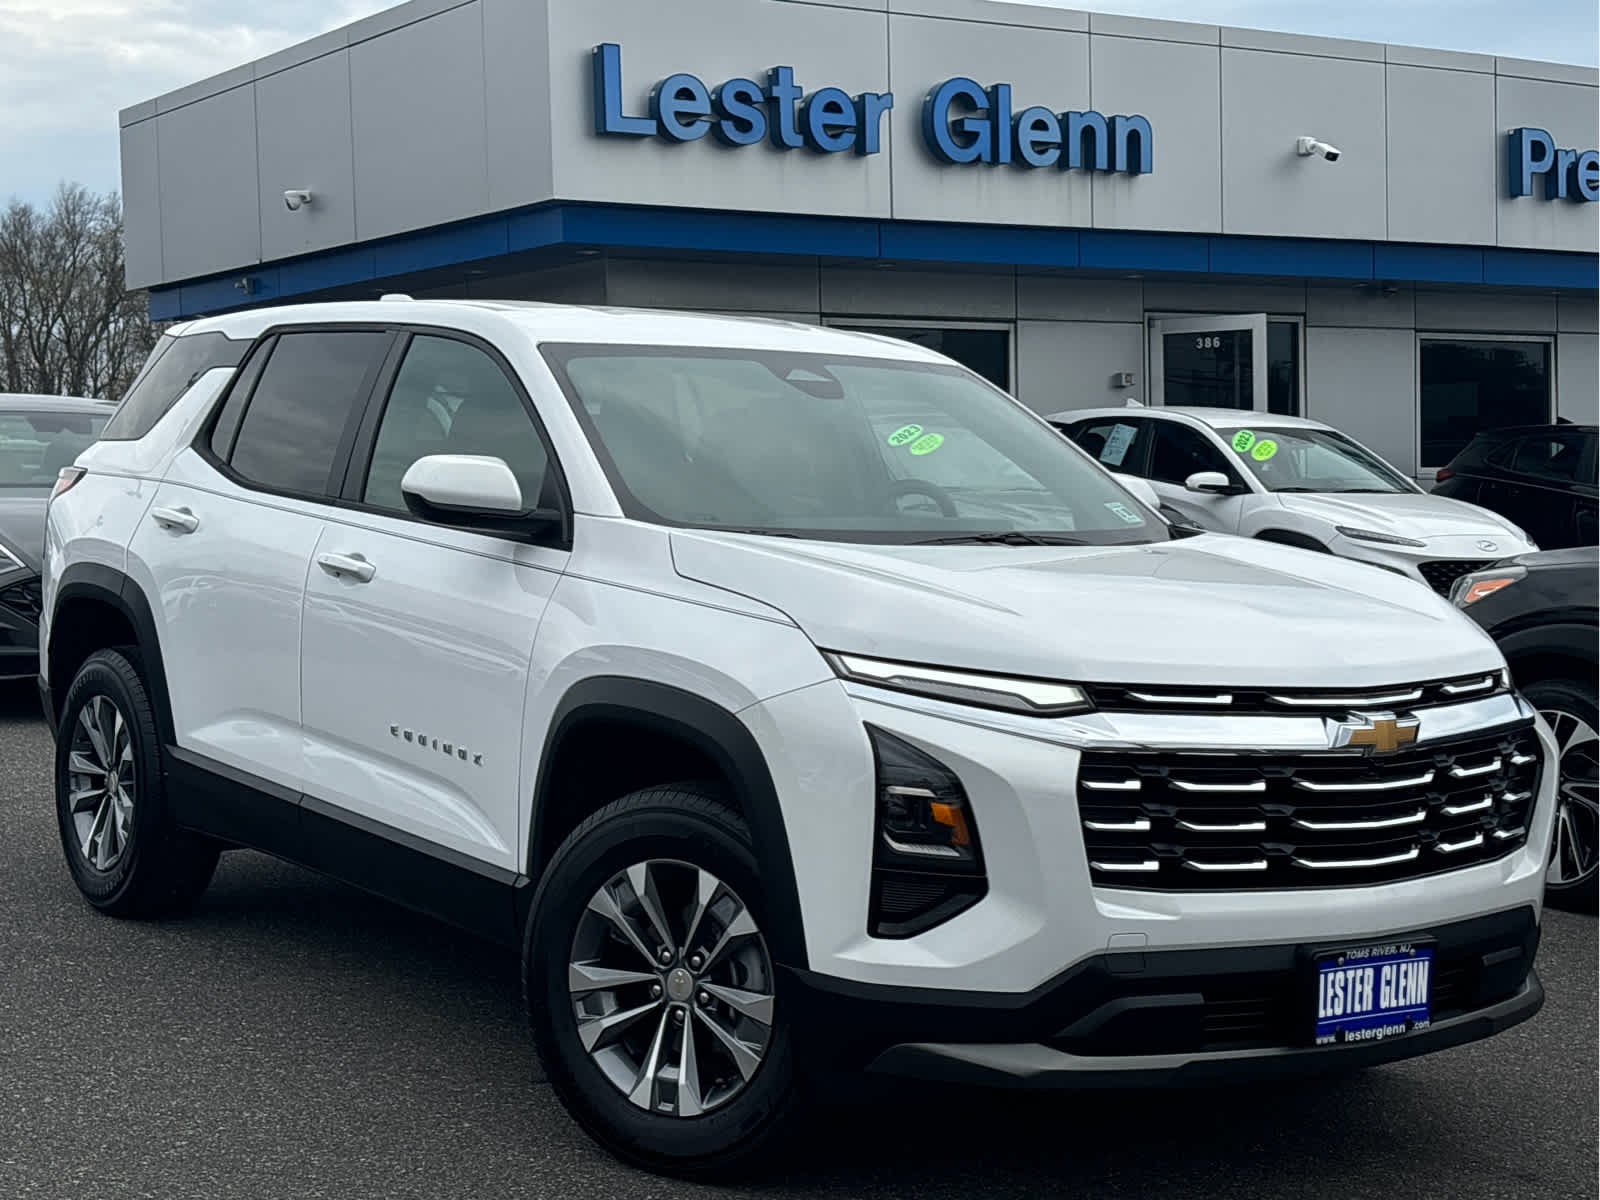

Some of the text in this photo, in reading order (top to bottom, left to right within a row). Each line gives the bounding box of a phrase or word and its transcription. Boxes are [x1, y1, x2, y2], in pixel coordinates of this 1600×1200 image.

[592, 43, 1152, 174] Lester Glenn
[1509, 127, 1599, 202] Pre
[1195, 336, 1221, 349] 386
[891, 425, 921, 444] 2023
[1234, 431, 1253, 450] 2023
[389, 725, 483, 768] EQUINOX
[1346, 948, 1369, 960] TOMS
[1318, 961, 1429, 1018] LESTER GLENN
[1344, 1024, 1406, 1042] lesterglenn
